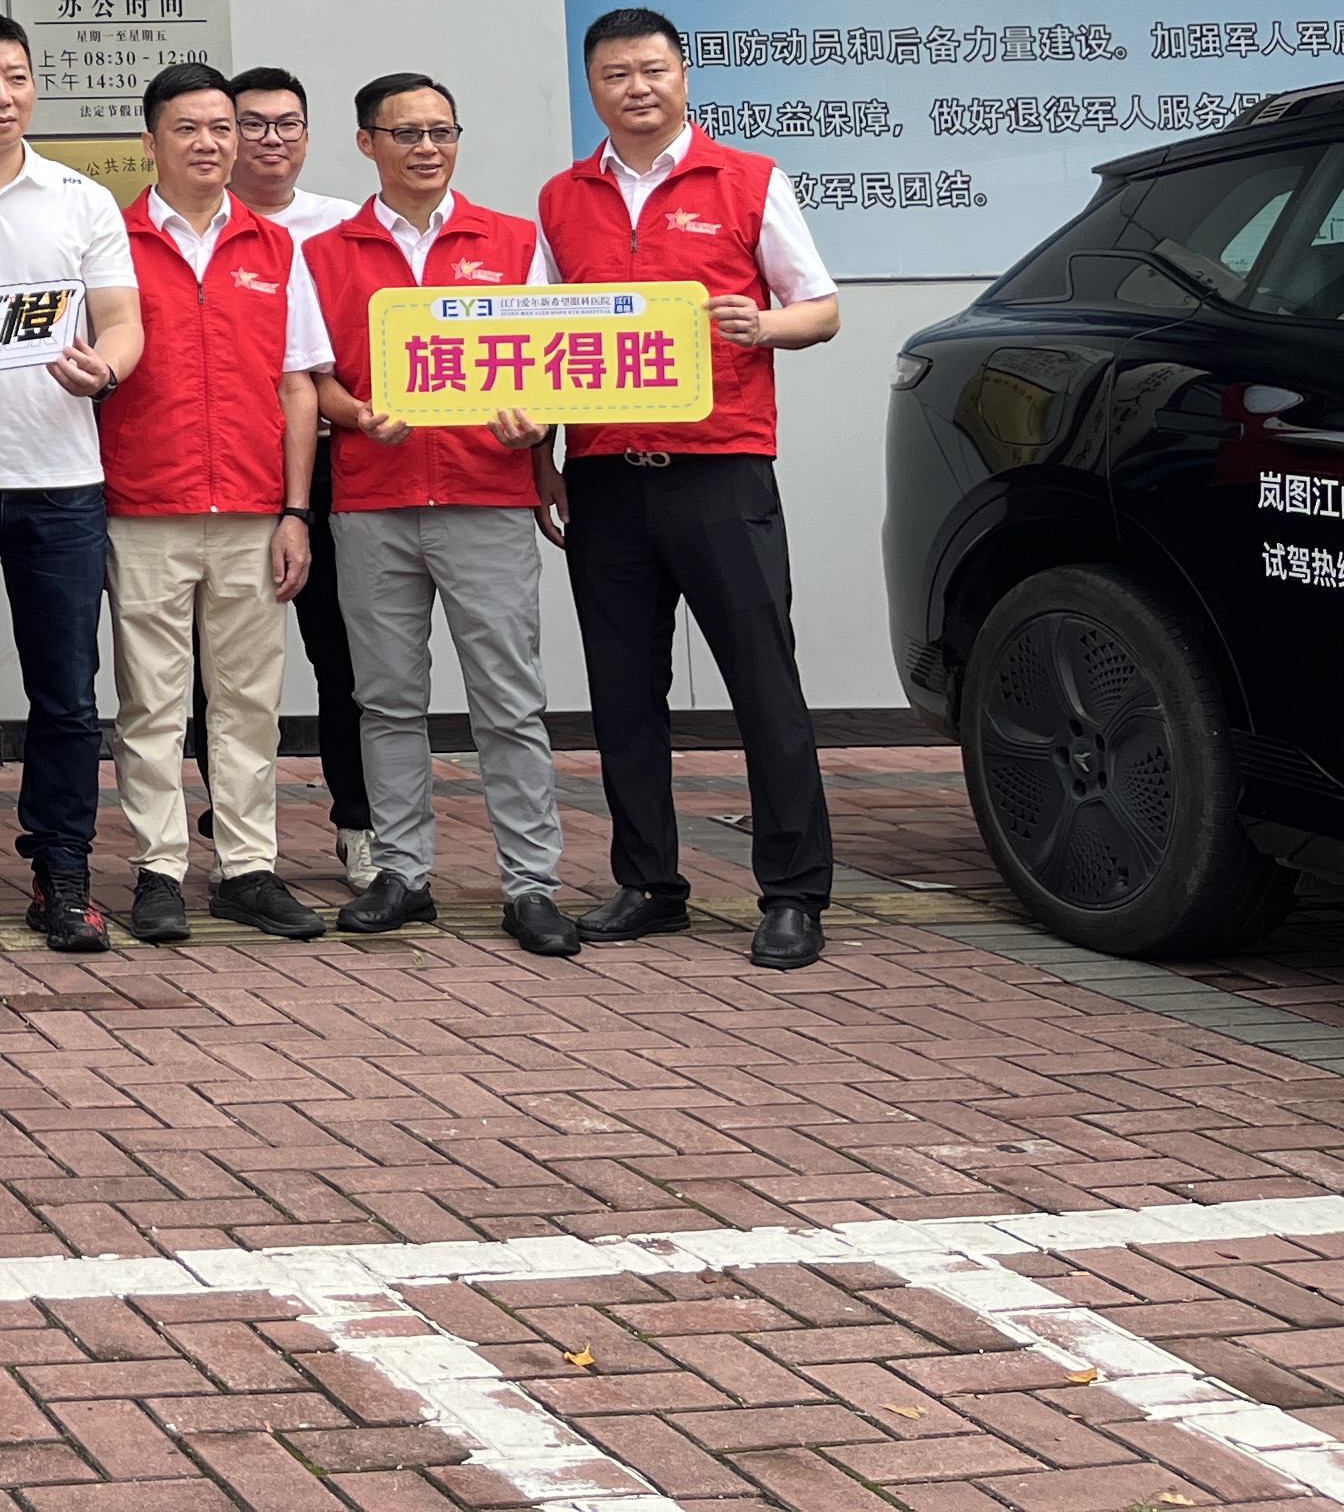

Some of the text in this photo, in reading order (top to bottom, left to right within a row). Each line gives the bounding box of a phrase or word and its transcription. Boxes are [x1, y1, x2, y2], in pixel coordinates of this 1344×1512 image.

[76, 29, 168, 43] 星期一至星期五
[38, 50, 78, 69] 上午
[84, 51, 136, 66] 08:30
[156, 50, 208, 65] 12:00
[38, 72, 79, 91] 下午
[85, 73, 137, 89] 14:30
[80, 105, 144, 118] 法定节假日
[404, 330, 679, 394] 旗开得胜
[1257, 471, 1344, 520] 岚图江
